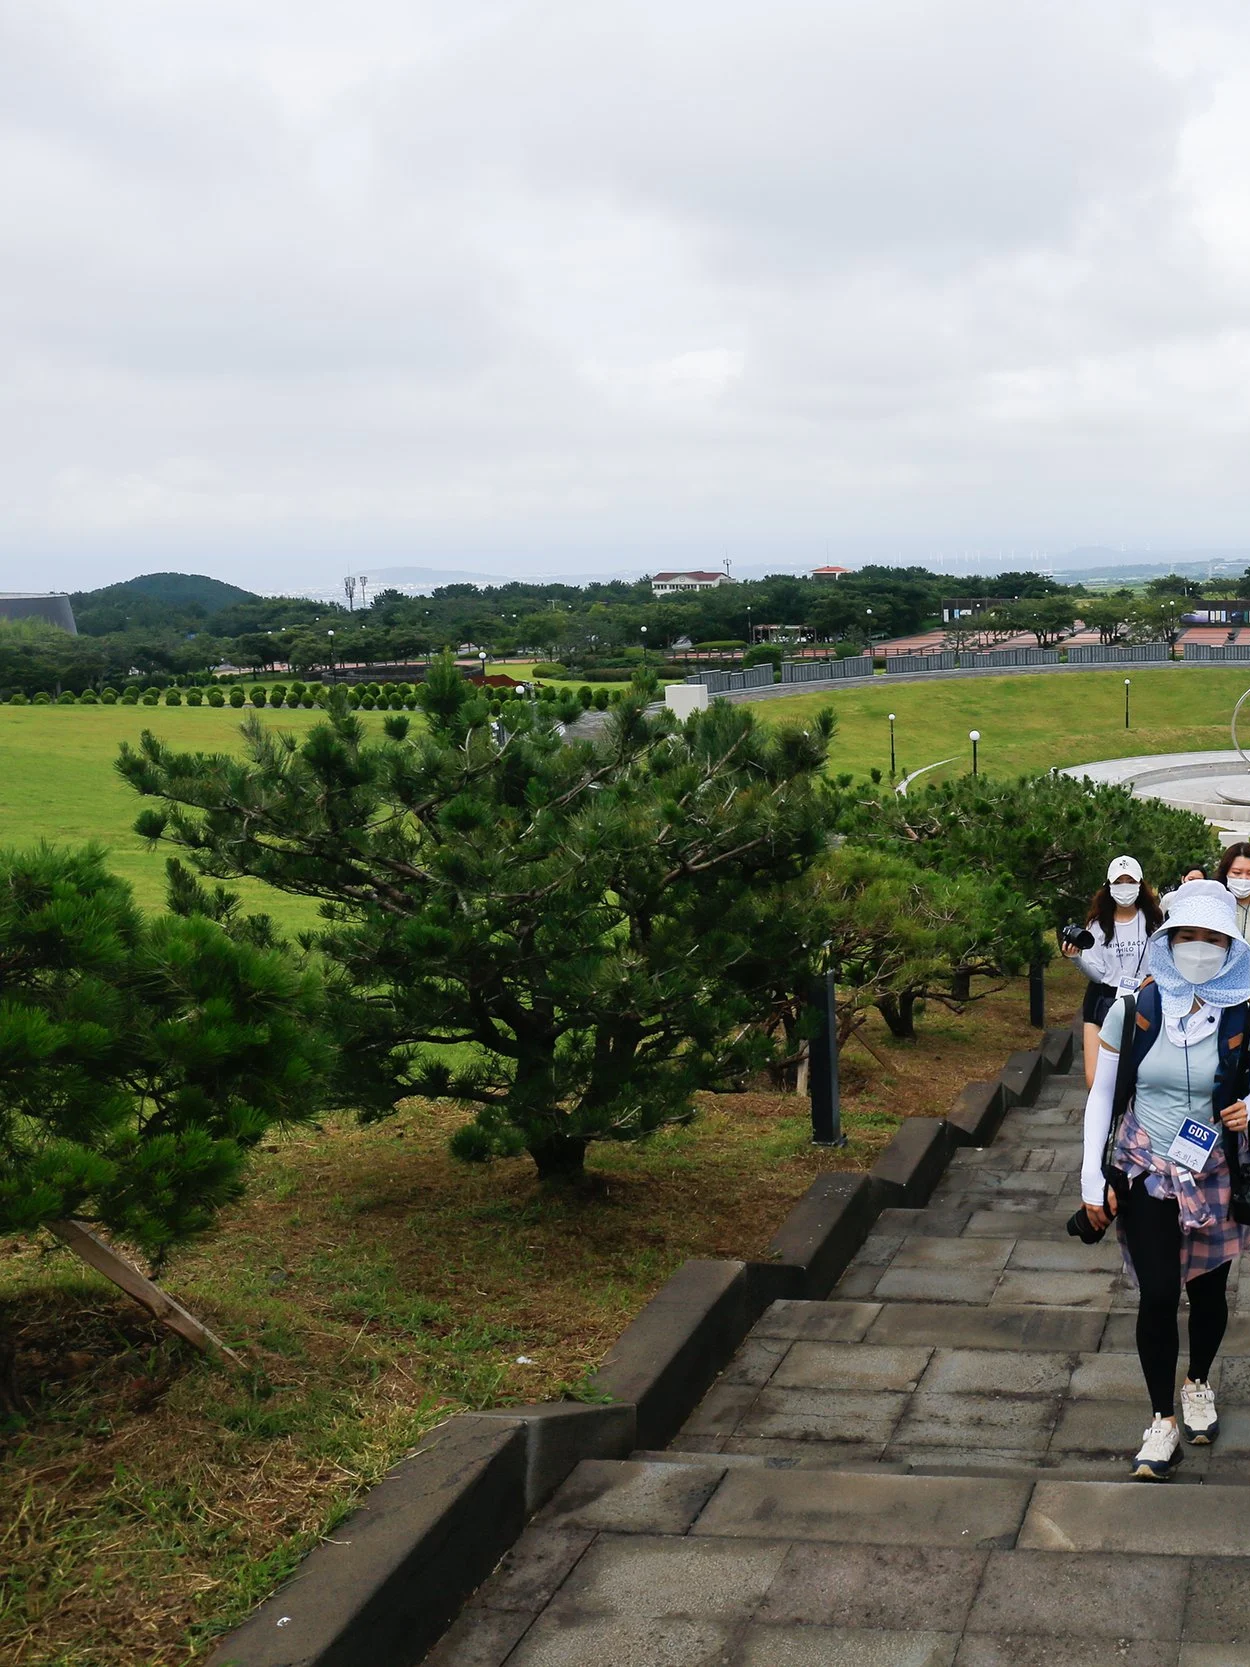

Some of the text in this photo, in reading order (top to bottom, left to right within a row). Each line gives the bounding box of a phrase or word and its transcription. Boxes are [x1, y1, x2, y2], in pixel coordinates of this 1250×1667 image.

[1107, 941, 1125, 949] RING
[1123, 978, 1135, 987] GDS
[1188, 1124, 1210, 1141] GDS
